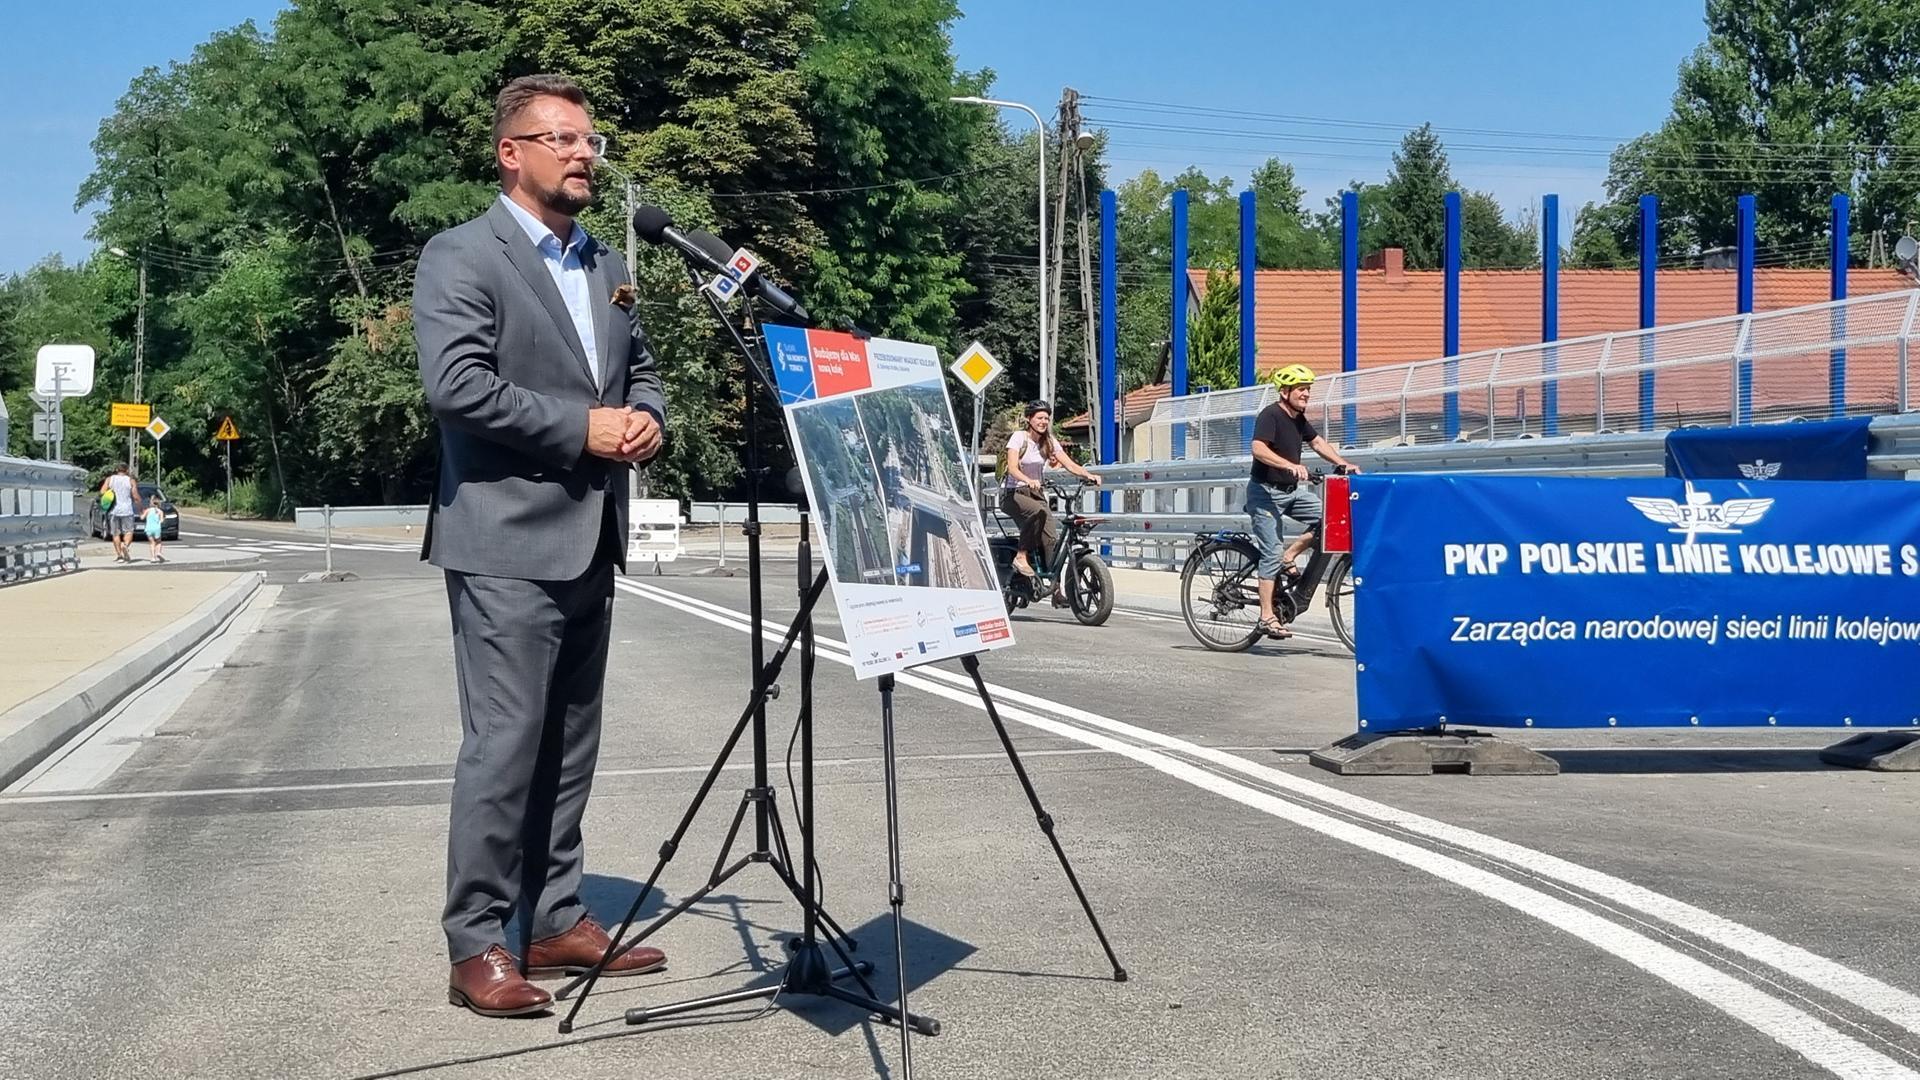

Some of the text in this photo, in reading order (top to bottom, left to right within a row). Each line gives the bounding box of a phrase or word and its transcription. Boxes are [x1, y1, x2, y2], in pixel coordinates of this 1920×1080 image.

[1680, 507, 1723, 522] PLK
[1444, 543, 1507, 575] PKP
[1520, 542, 1645, 574] POLSKIE
[1656, 542, 1732, 573] LINIE
[1739, 543, 1892, 575] KOLEJOWE
[1450, 614, 1920, 647] Zarządca narodowej sieci linii kolejow
